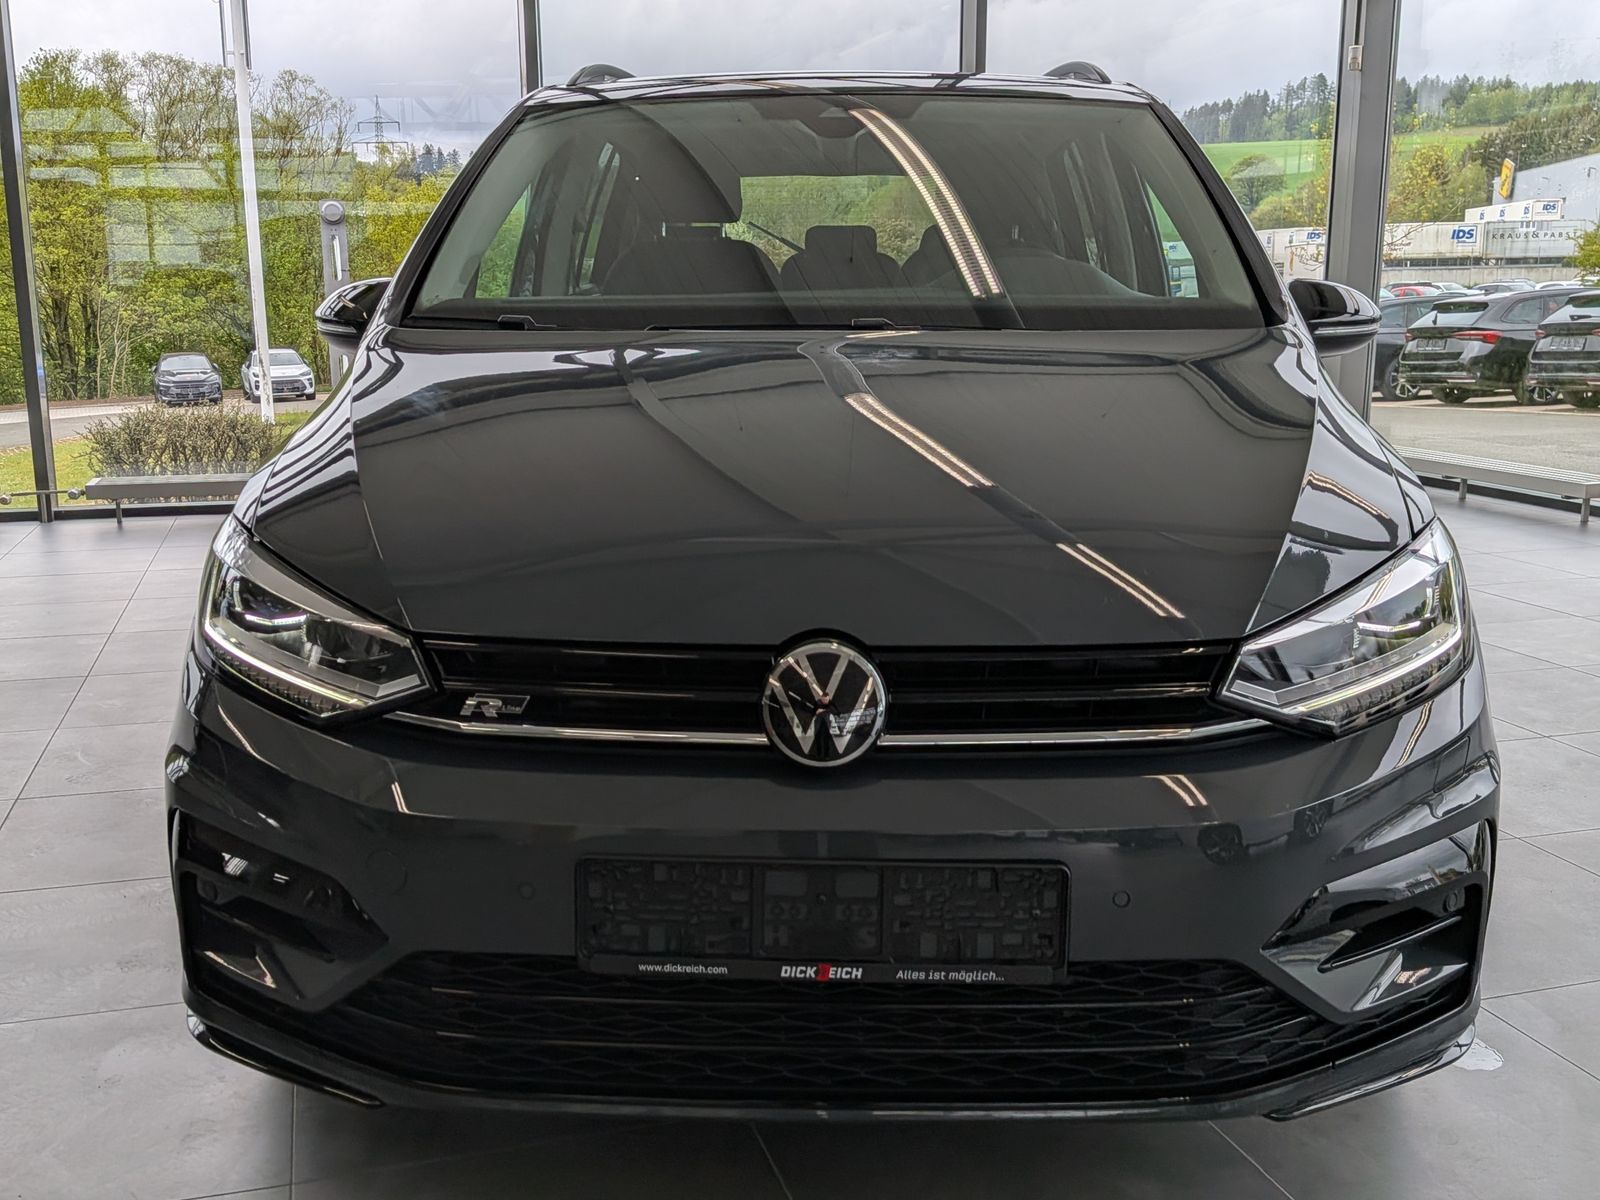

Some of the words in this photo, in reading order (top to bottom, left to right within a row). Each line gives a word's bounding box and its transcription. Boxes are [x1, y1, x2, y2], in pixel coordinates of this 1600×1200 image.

[1542, 203, 1557, 211] IDS
[1306, 231, 1323, 241] IDS
[1451, 229, 1475, 241] IDS
[460, 696, 502, 718] R
[638, 963, 729, 976] www.dickreich.com
[896, 969, 926, 980] Alles
[928, 969, 947, 980] ist
[948, 970, 1005, 983] möglich...
